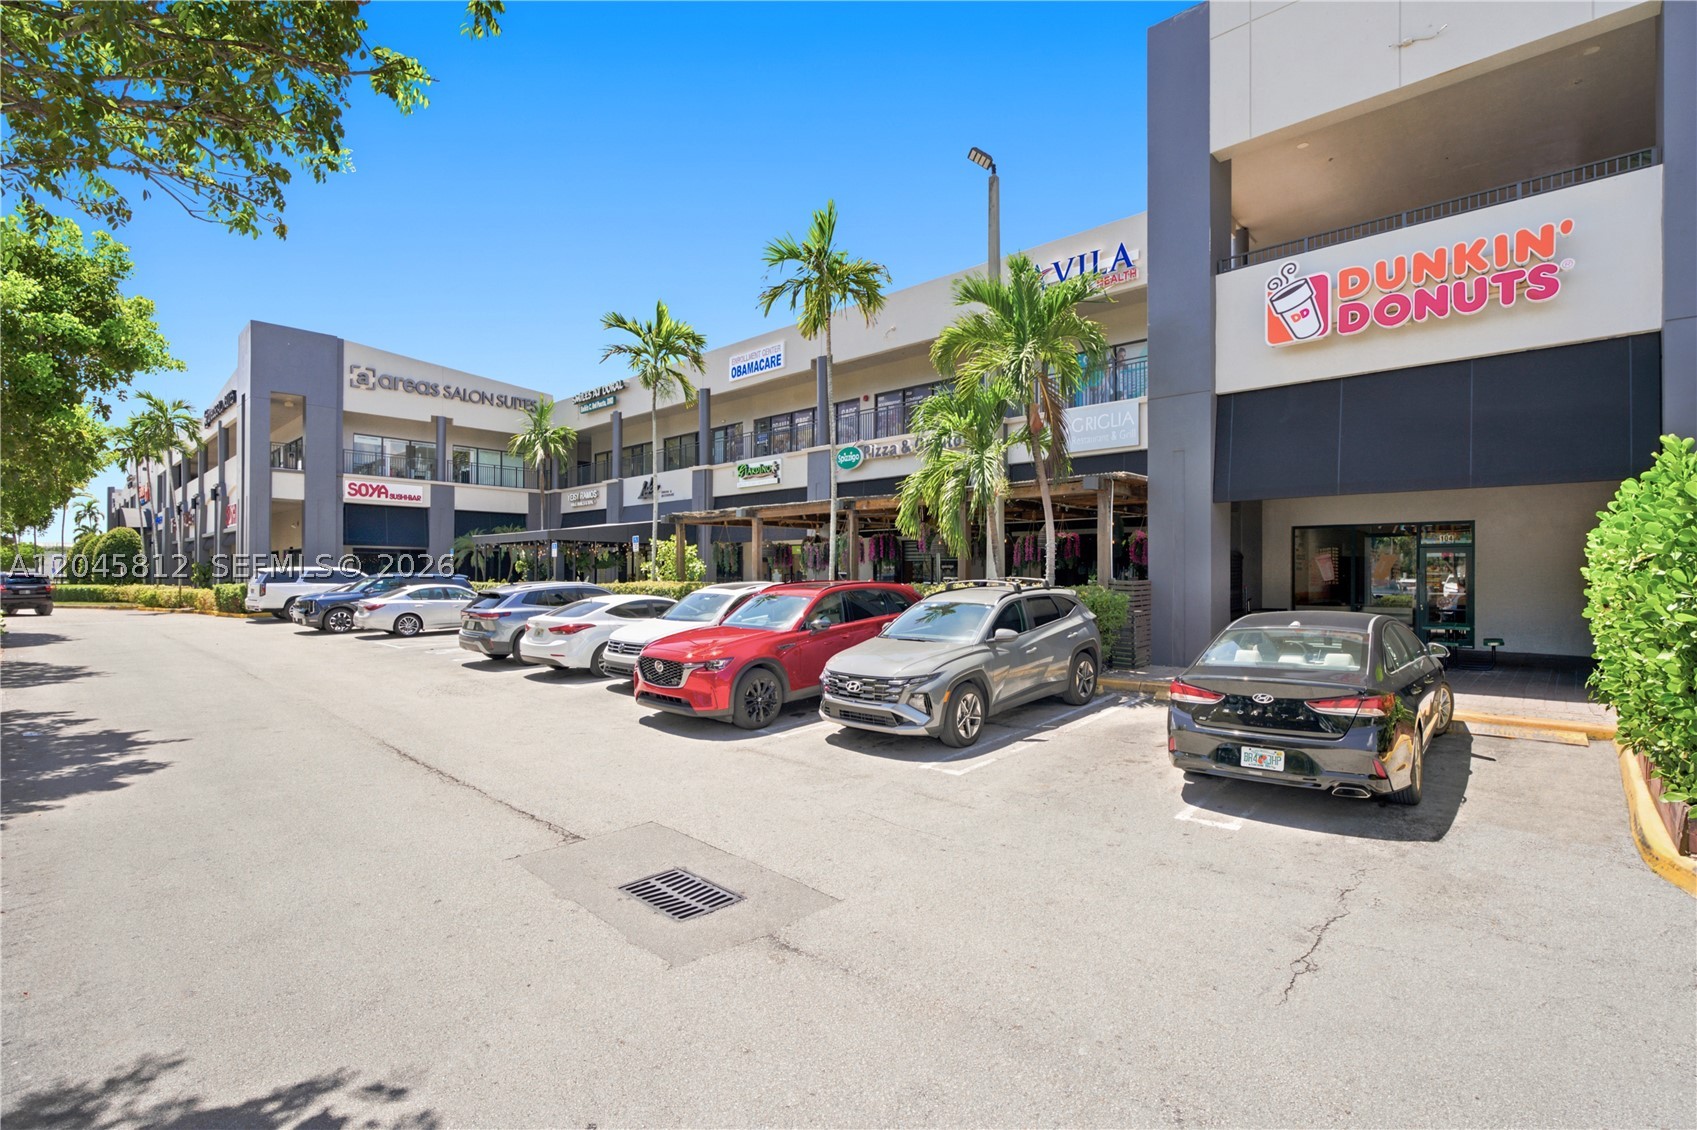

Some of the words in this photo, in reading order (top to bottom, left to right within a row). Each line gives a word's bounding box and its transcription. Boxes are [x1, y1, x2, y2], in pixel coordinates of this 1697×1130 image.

[1337, 218, 1574, 300] DUNKIN'
[1096, 267, 1137, 287] HEALTH
[1337, 262, 1562, 336] DONUTS
[731, 350, 762, 366] ENROLLMENT
[762, 345, 782, 357] CENTER
[731, 353, 782, 379] OBAMACARE
[378, 374, 441, 397] areas
[443, 385, 494, 406] SALON
[496, 394, 538, 413] SUITES
[1071, 411, 1135, 433] GRIGLIA
[1111, 430, 1118, 441] &
[1119, 428, 1136, 440] Grill
[838, 451, 860, 465] Spizzigo
[863, 444, 898, 459] Pizza
[901, 439, 912, 454] &
[347, 482, 389, 499] SOYA
